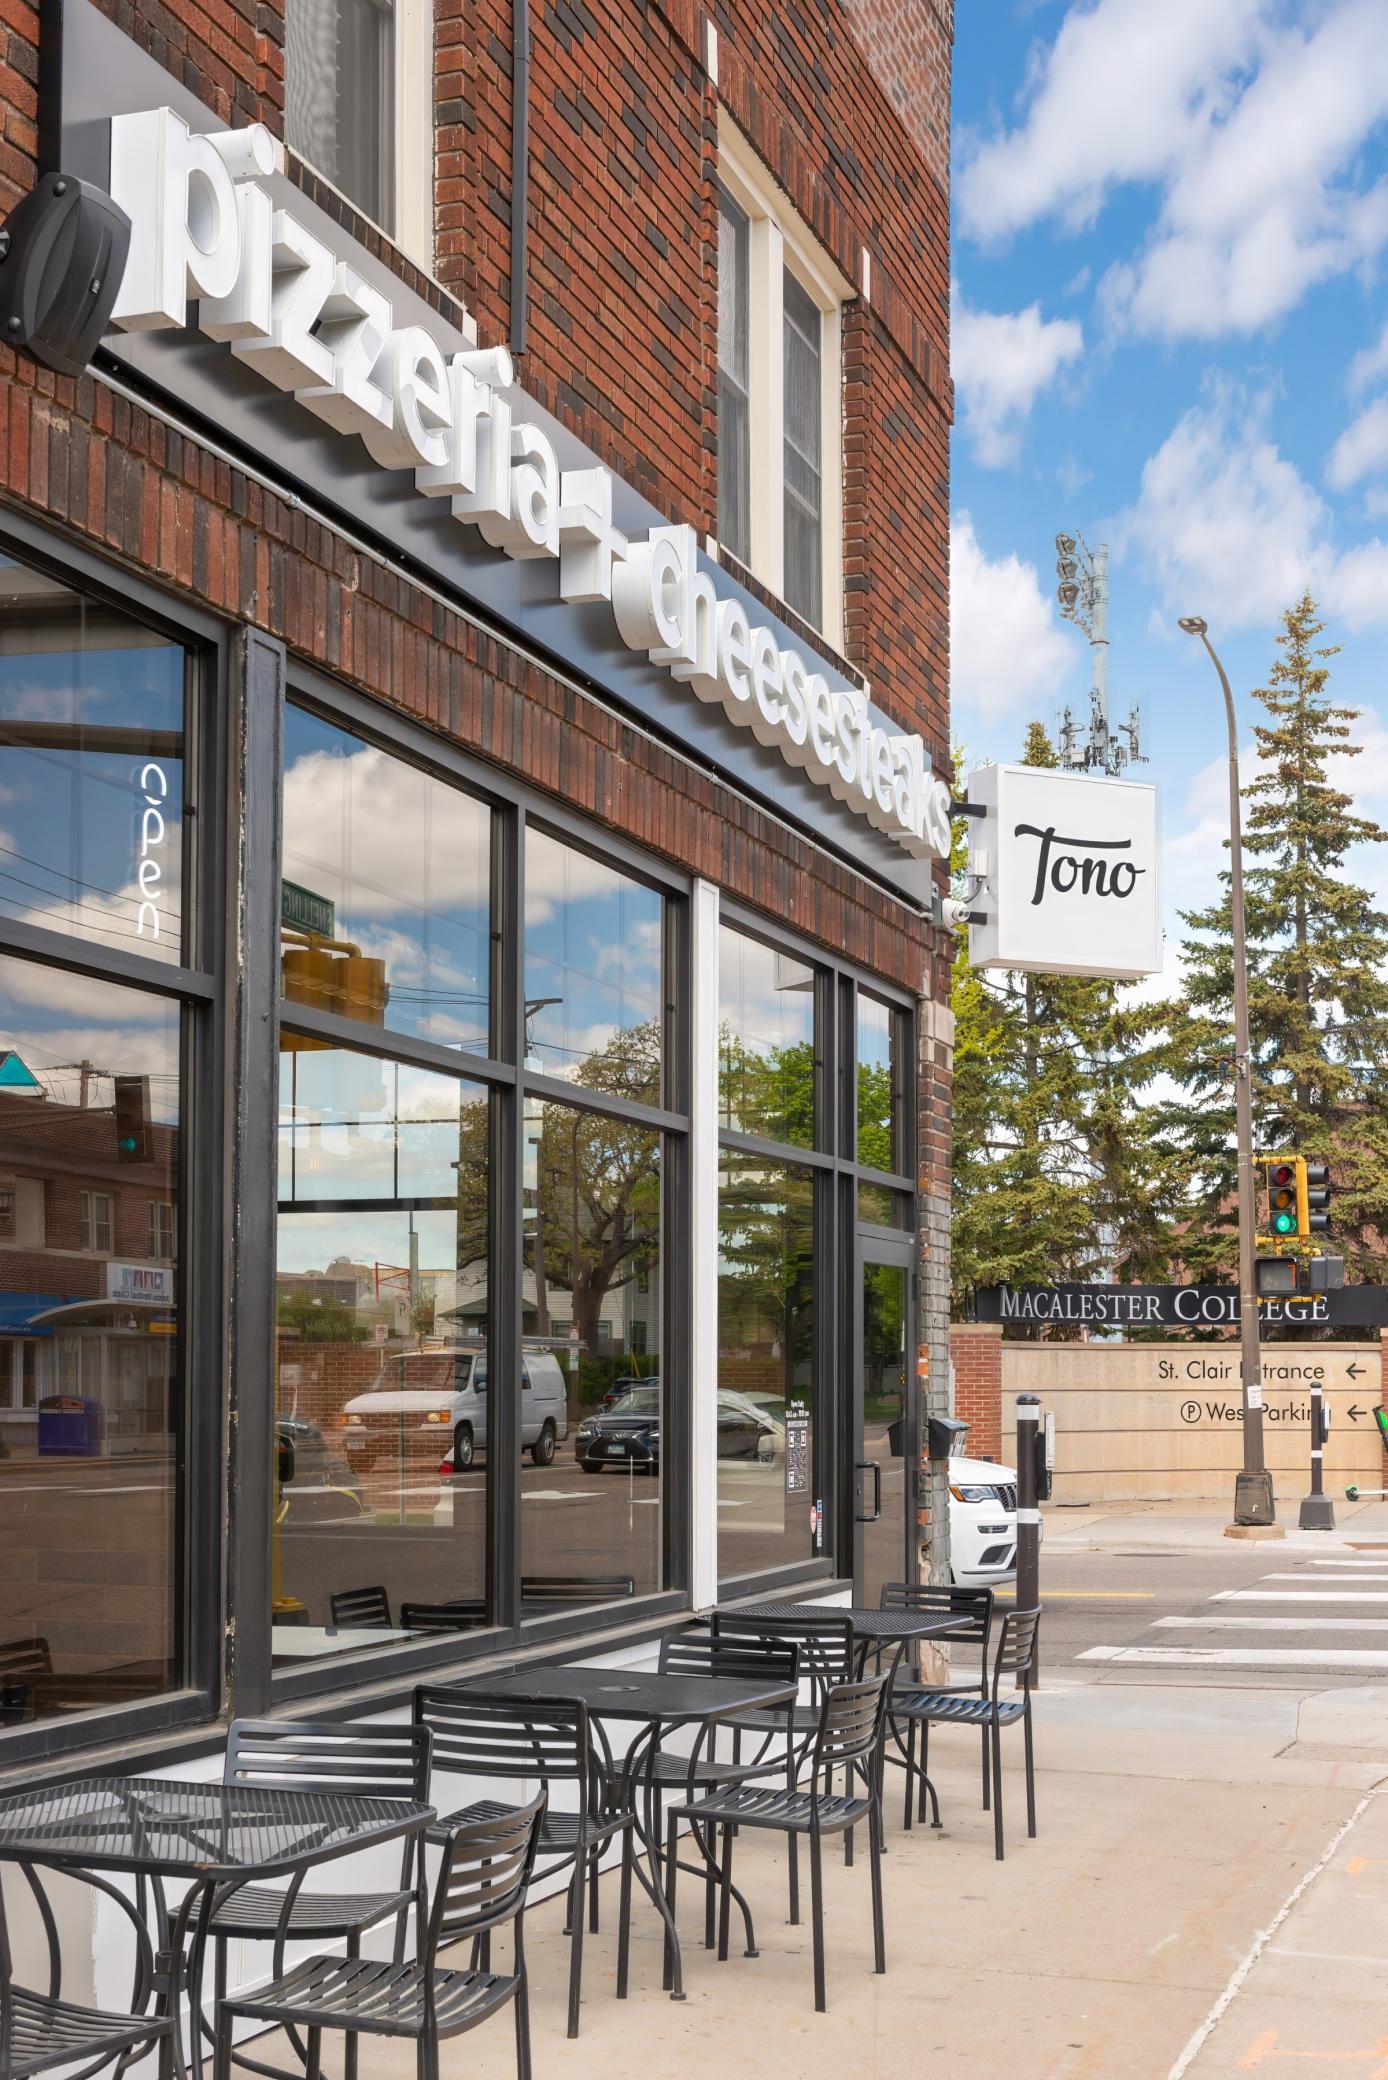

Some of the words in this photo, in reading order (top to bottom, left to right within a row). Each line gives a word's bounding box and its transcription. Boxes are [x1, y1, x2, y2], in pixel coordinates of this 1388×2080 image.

[111, 107, 559, 560] pizzeria
[612, 524, 951, 858] cheesesteaks
[1014, 824, 1146, 905] Tono
[1000, 1285, 1164, 1321] MACALESTER
[1174, 1289, 1330, 1321] COLEGE
[1159, 1360, 1178, 1379] St.
[1187, 1360, 1232, 1379] Clair
[1240, 1361, 1325, 1379] trance
[1206, 1402, 1244, 1421] Wes
[1261, 1401, 1312, 1421] Parki
